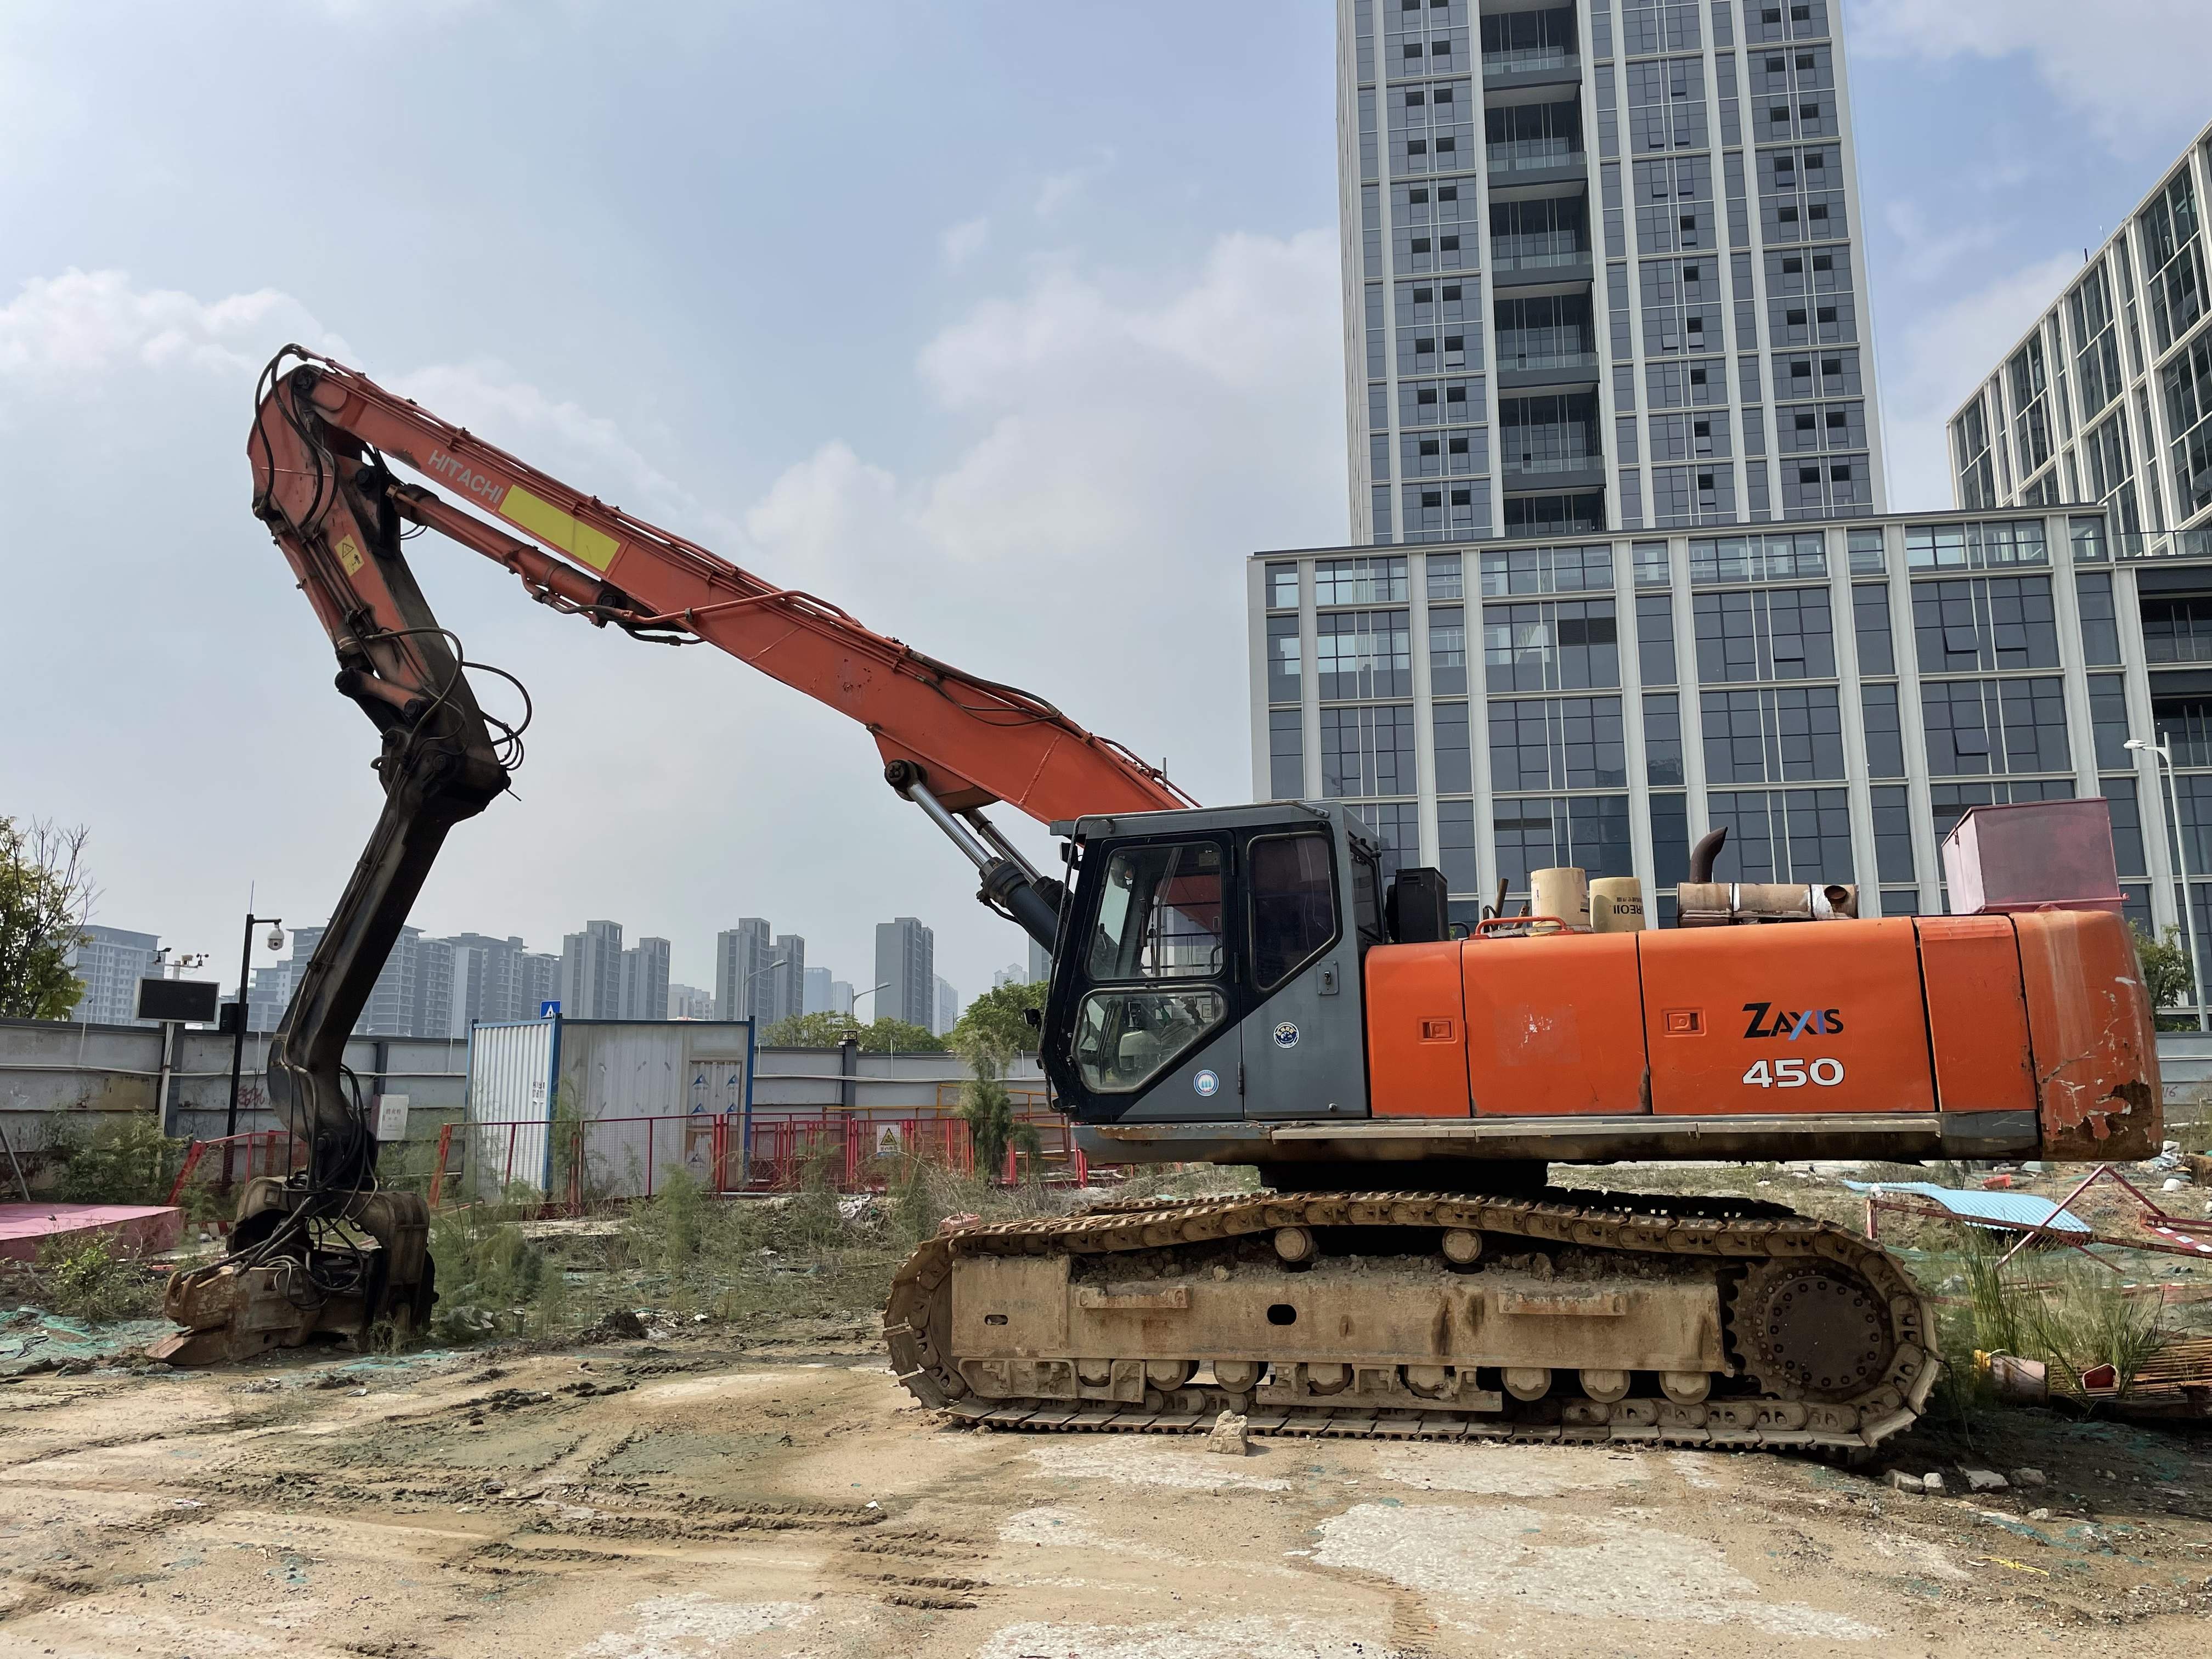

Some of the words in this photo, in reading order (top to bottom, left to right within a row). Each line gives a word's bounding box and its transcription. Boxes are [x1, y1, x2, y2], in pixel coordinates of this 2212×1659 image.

[427, 449, 504, 503] HITACHI
[1742, 1002, 1843, 1041] ZAXIS
[1742, 1057, 1845, 1088] 450
